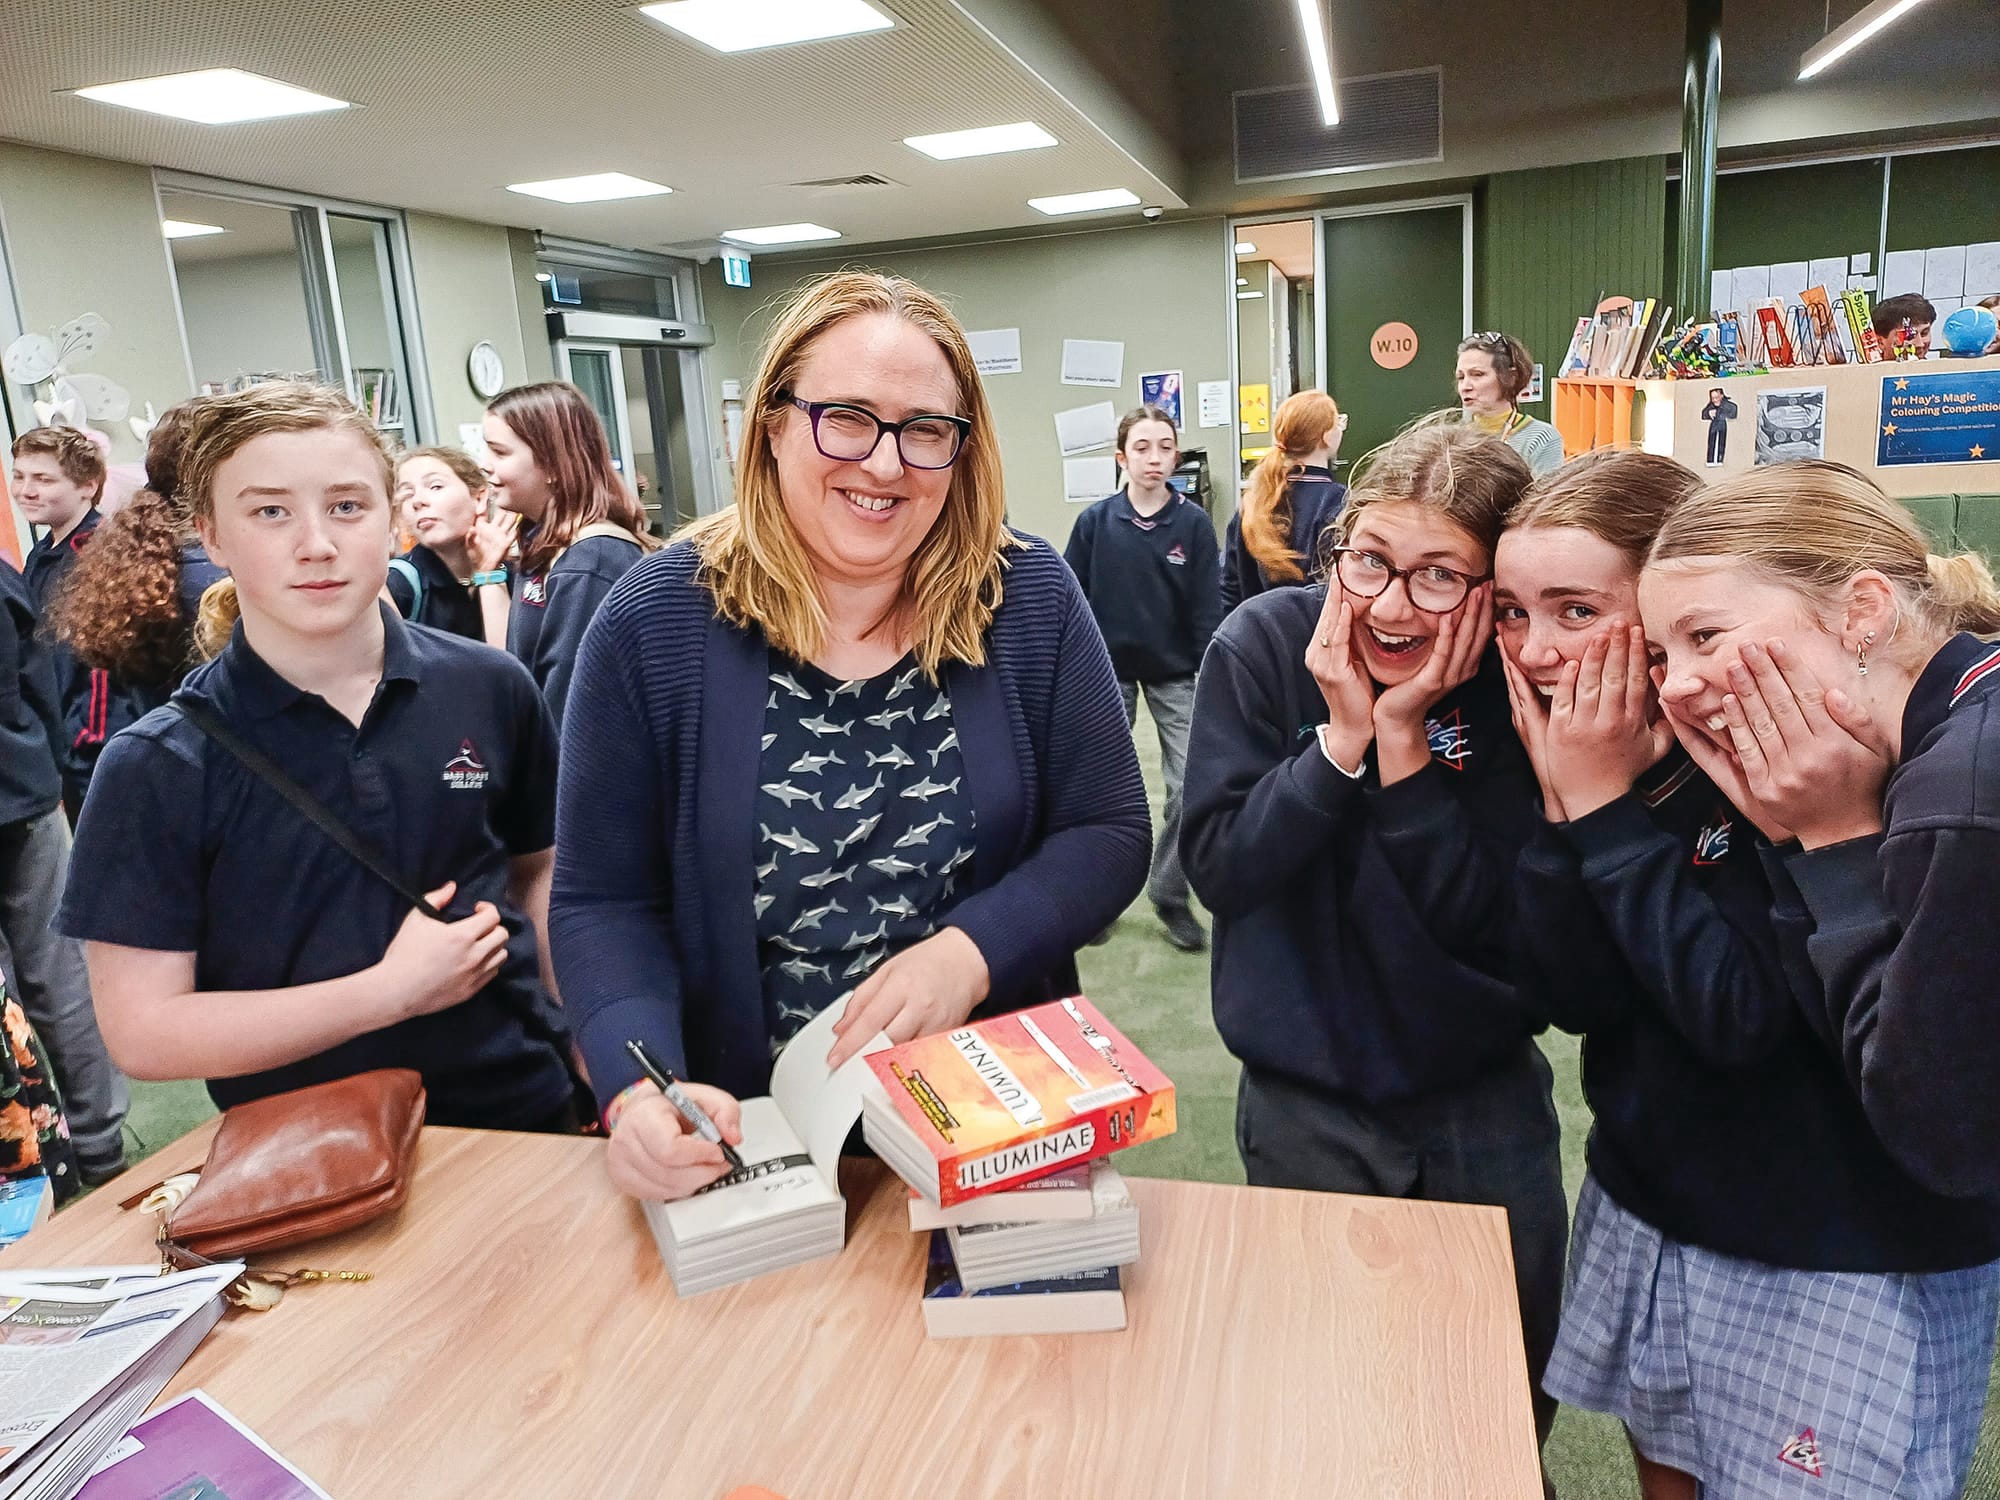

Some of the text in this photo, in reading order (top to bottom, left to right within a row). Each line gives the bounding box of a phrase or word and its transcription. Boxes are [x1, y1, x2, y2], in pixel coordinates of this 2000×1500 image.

[1854, 294, 1868, 327] Sports
[1377, 338, 1412, 353] W.10
[1892, 392, 1977, 406] Mr Hay's Magic
[1890, 407, 1940, 417] Colouring
[959, 1126, 1092, 1187] ILLUMINAE
